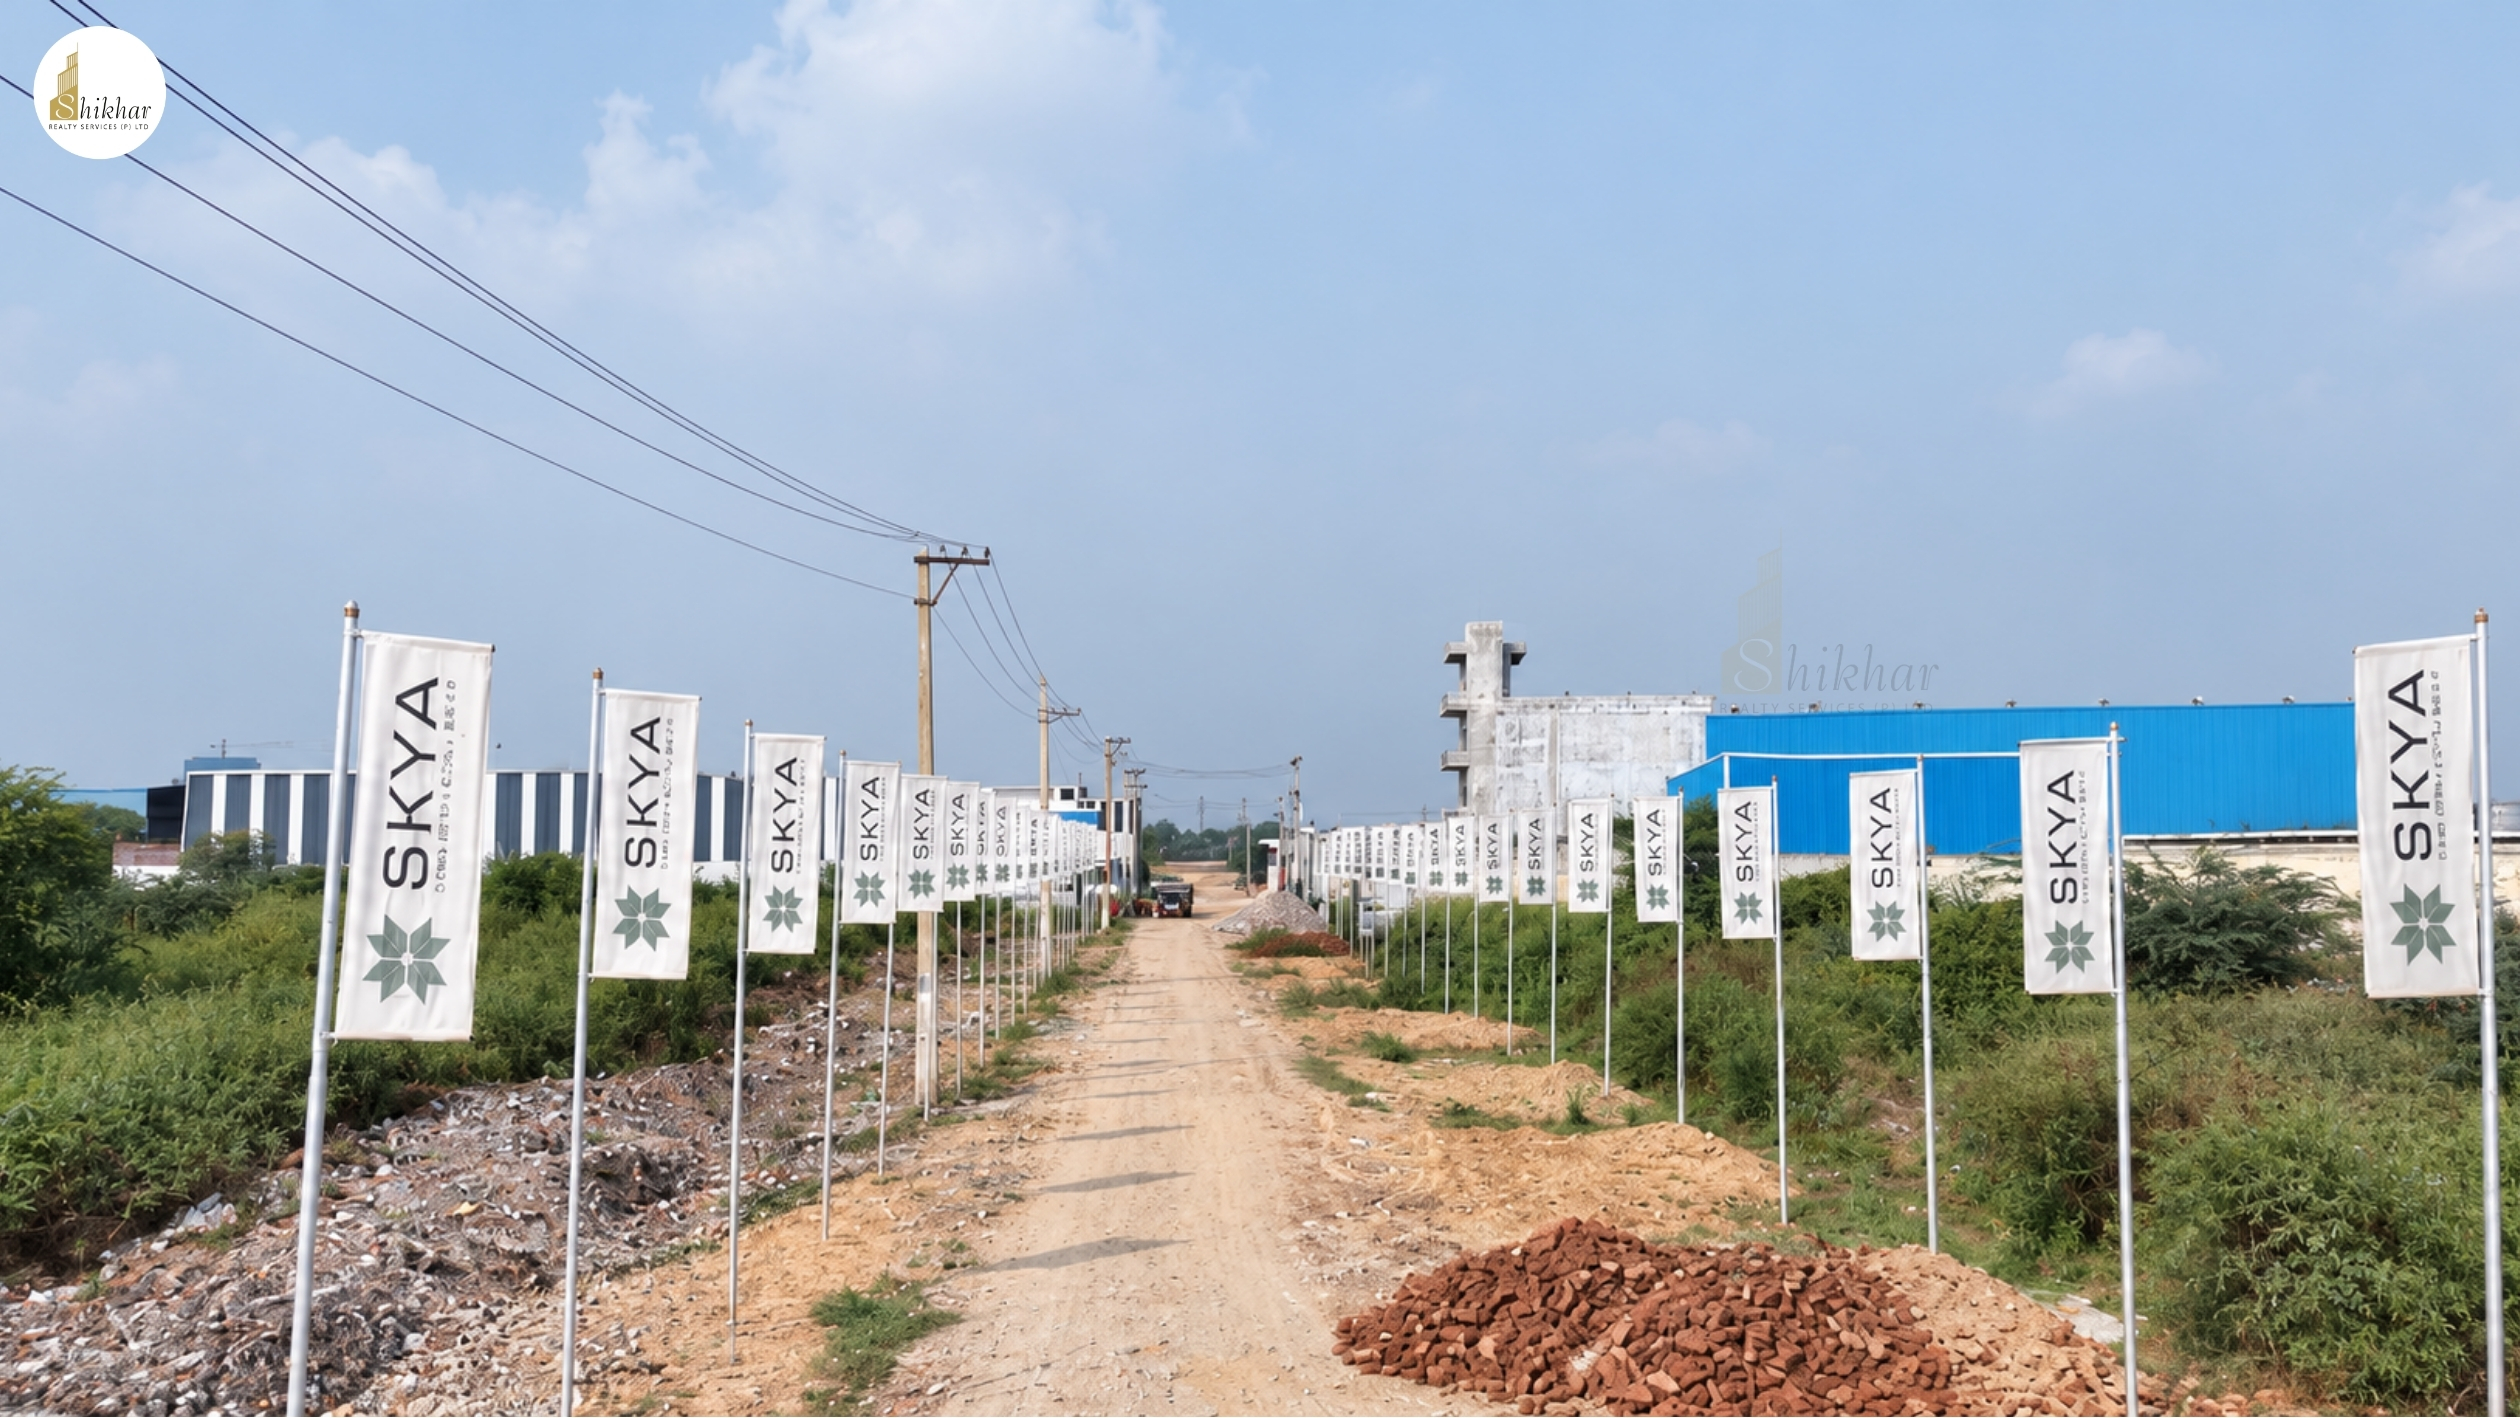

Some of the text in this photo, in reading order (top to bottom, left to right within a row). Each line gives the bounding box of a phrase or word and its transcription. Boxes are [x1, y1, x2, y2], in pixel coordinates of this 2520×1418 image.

[382, 677, 439, 890] SKYA
[624, 716, 661, 868] SKYA
[2387, 669, 2433, 861] SKYA
[771, 757, 798, 873] SKYA
[860, 776, 880, 861] SKYA
[913, 788, 930, 860] SKYA
[951, 793, 965, 856] SKYA
[1528, 817, 1542, 870] SKYA
[1579, 812, 1594, 872] SKYA
[1646, 809, 1663, 876] SKYA
[1735, 801, 1754, 882] SKYA
[1869, 787, 1894, 889] SKYA
[2046, 770, 2078, 904] SKYA
